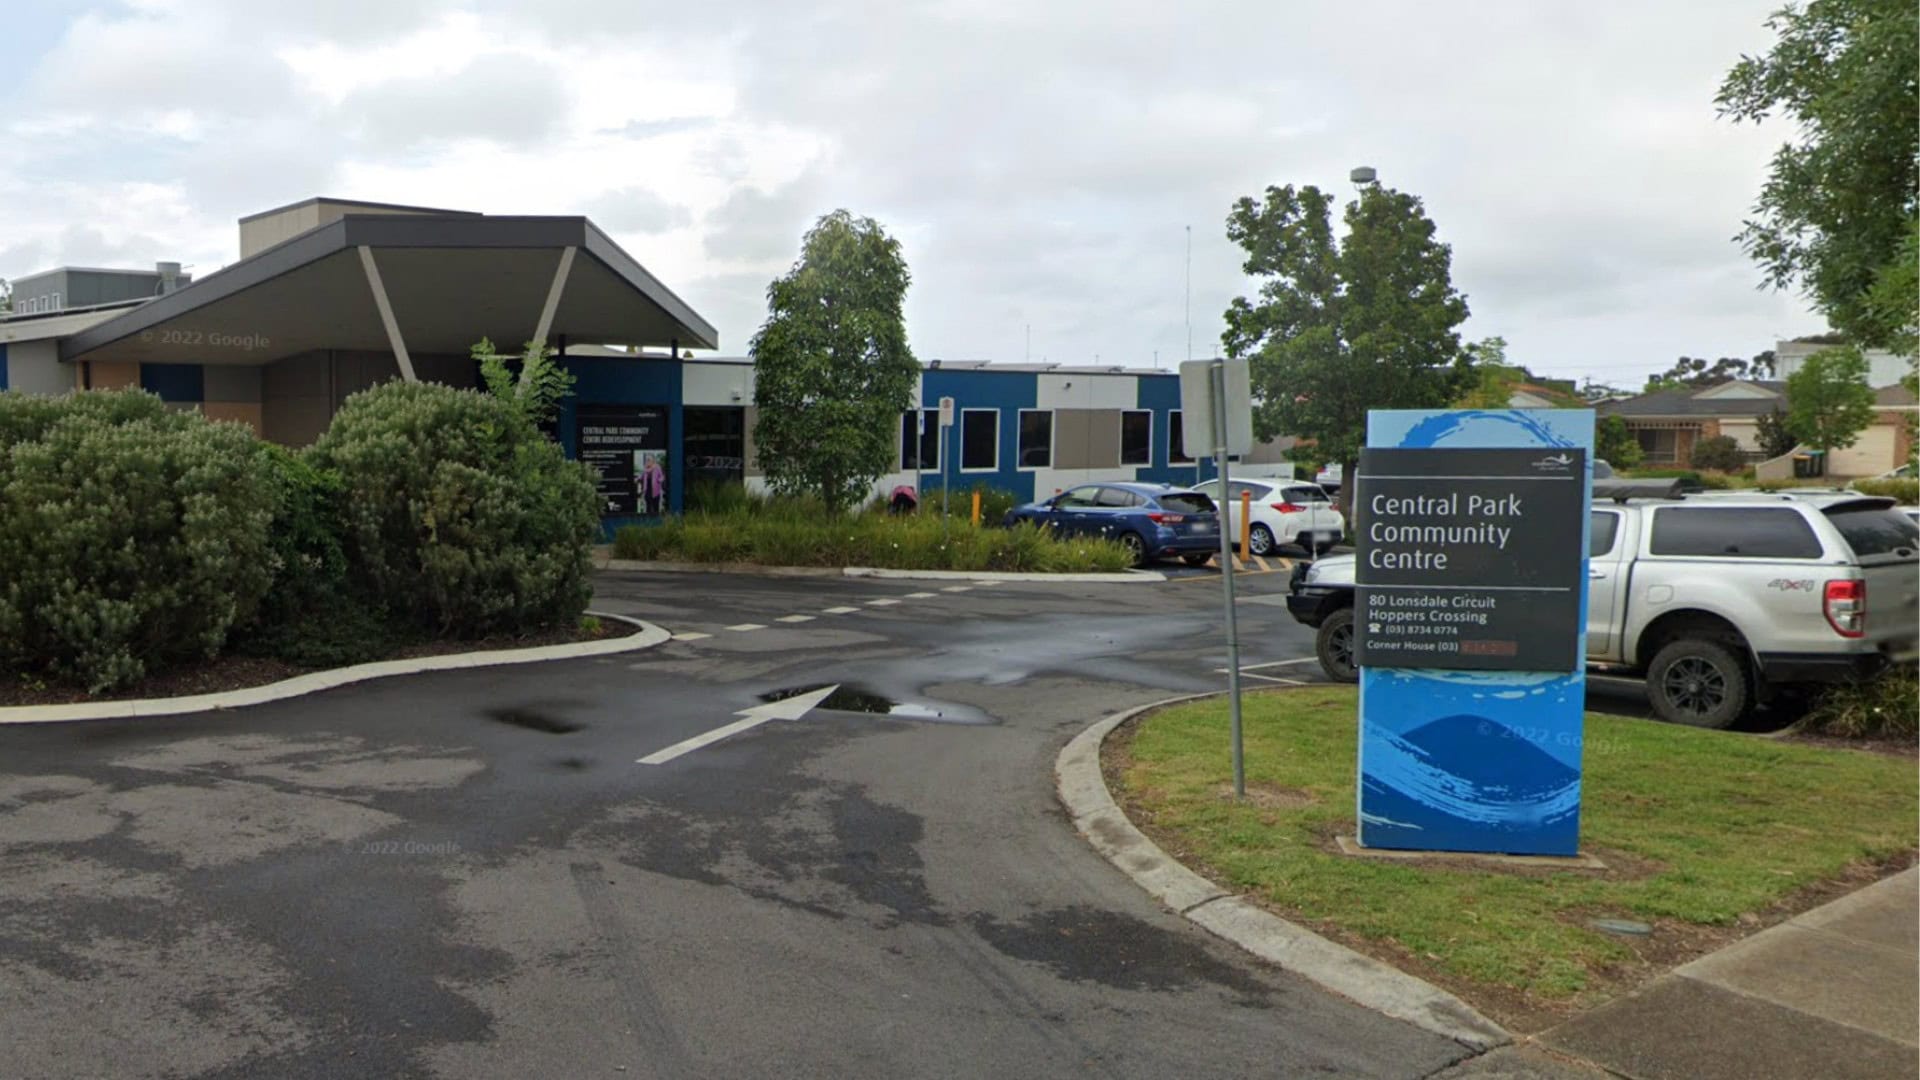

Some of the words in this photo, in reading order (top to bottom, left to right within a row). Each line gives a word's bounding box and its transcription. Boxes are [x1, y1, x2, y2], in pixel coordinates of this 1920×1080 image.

[1372, 493, 1457, 516] Central
[1468, 493, 1522, 517] Park
[1370, 522, 1511, 549] Community
[1369, 548, 1448, 570] Centre
[1368, 594, 1387, 607] 80
[1389, 595, 1449, 608] Lonsdale
[1451, 596, 1496, 609] Circuit
[1368, 609, 1426, 623] Hoppers
[1429, 610, 1488, 625] Crossing
[1385, 624, 1406, 636] (03)
[1407, 625, 1431, 635] 8734
[1433, 626, 1459, 636] 0774
[1366, 640, 1402, 650] Corner
[1403, 640, 1436, 651] House
[1437, 641, 1459, 653] (03)
